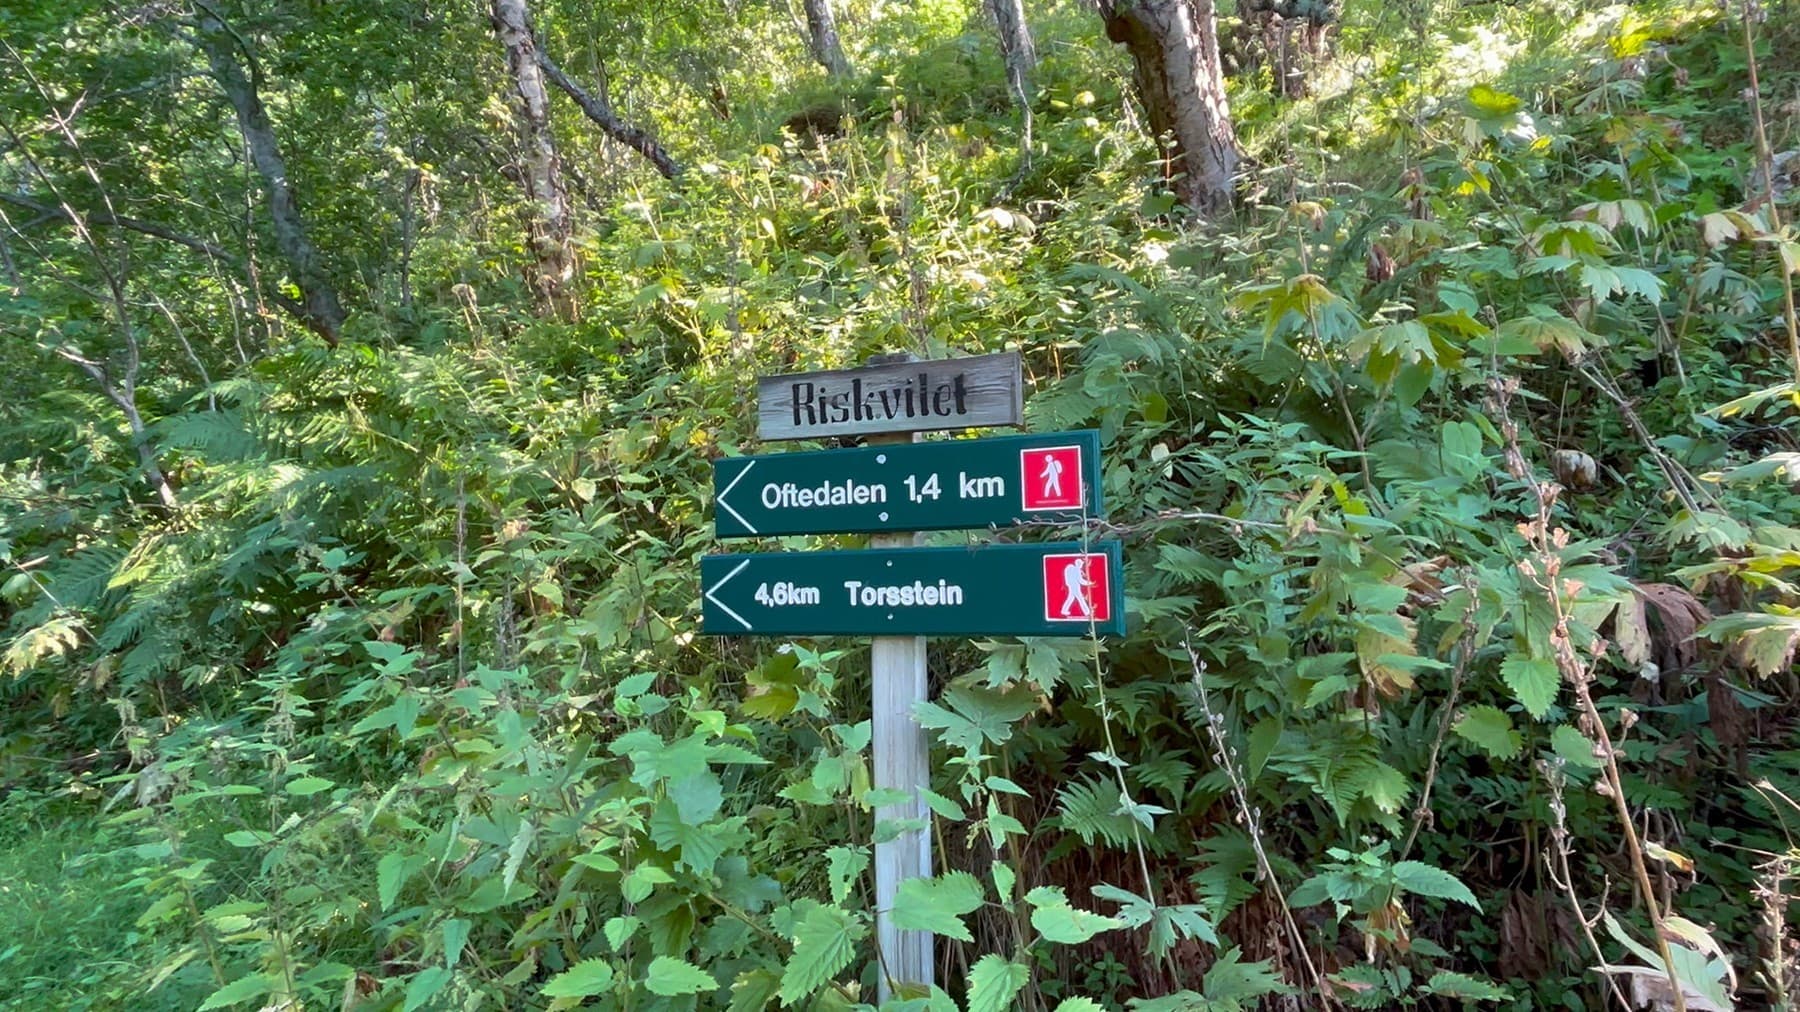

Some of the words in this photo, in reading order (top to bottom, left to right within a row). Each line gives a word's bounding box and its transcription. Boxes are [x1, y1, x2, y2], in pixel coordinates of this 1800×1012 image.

[792, 373, 968, 426] Riskvilet
[761, 479, 887, 509] Oftedalen
[903, 473, 941, 503] 1,4
[959, 471, 1005, 498] km
[754, 581, 820, 608] 4,6km
[844, 579, 963, 606] Torsstein
